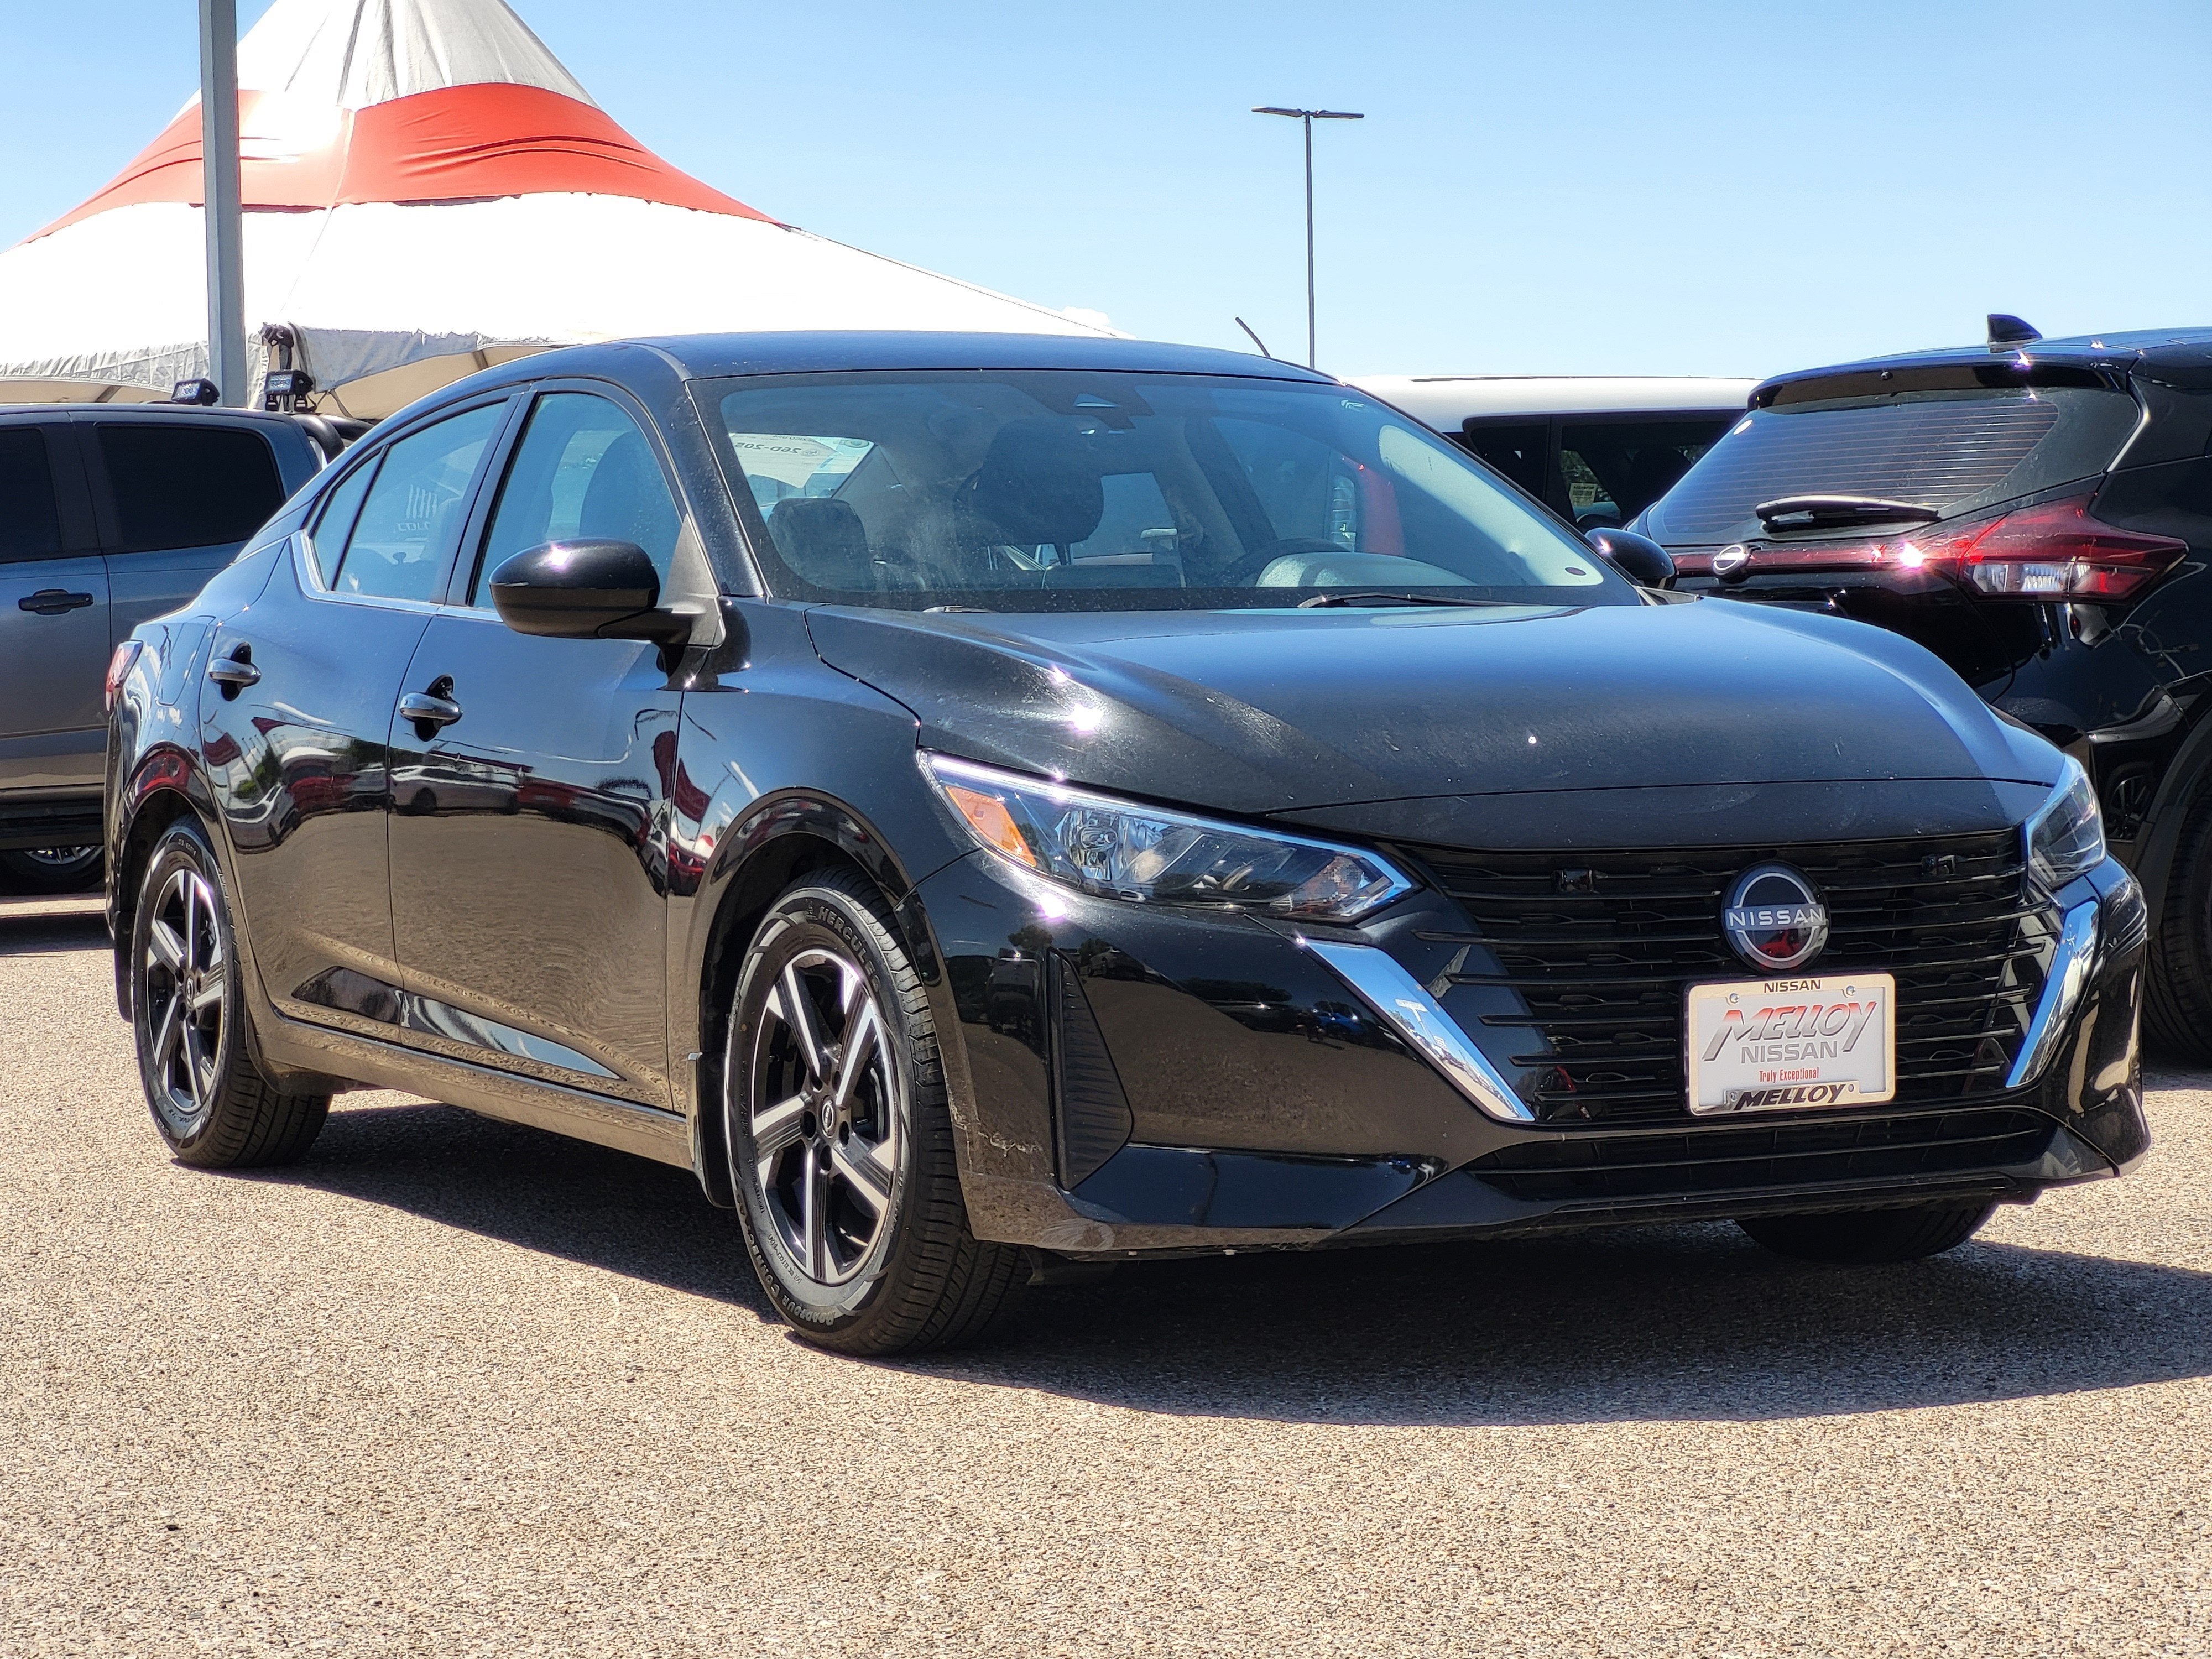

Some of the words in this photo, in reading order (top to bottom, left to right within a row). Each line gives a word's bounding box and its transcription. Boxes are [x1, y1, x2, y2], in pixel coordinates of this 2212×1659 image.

[1729, 909, 1823, 926] NISSAN
[818, 906, 881, 993] HERCULES
[1764, 979, 1821, 993] NISSAN
[1702, 1001, 1877, 1061] MELLOY
[1741, 1041, 1838, 1064] NISSAN
[1759, 1070, 1777, 1083] Truly
[1780, 1067, 1819, 1081] Exceptional
[1733, 1083, 1845, 1110] MELLOY
